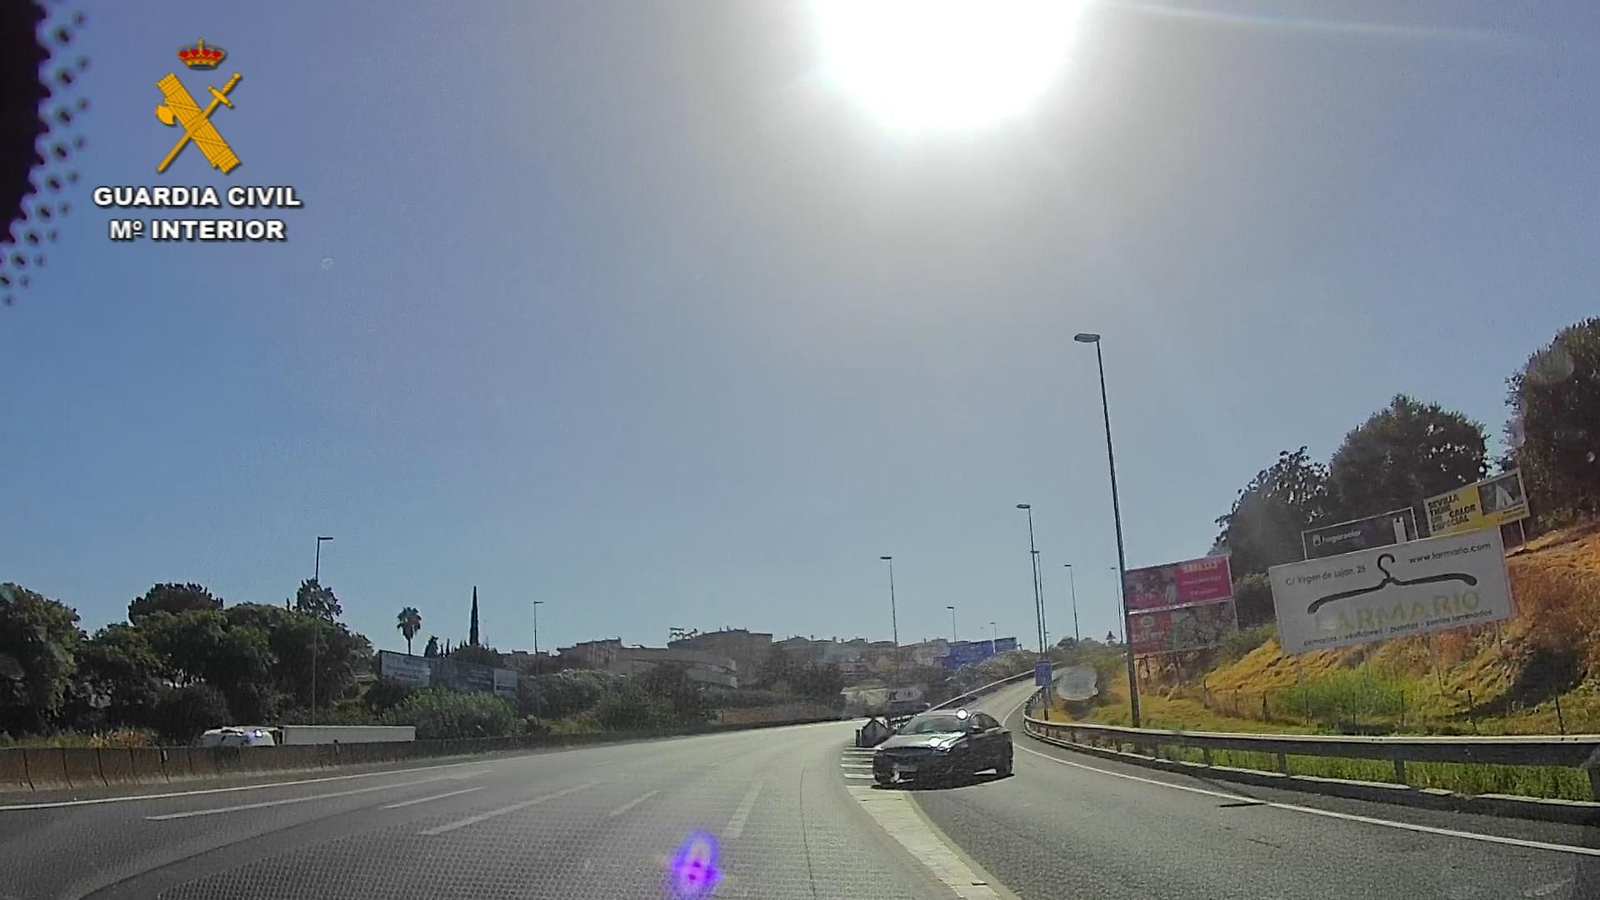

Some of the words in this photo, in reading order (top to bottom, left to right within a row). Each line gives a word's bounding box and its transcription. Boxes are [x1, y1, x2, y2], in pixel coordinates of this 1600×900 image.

[1428, 494, 1459, 508] SEVILLA
[1449, 504, 1476, 517] CALOR
[1297, 574, 1321, 584] Virgen
[1322, 571, 1332, 580] de
